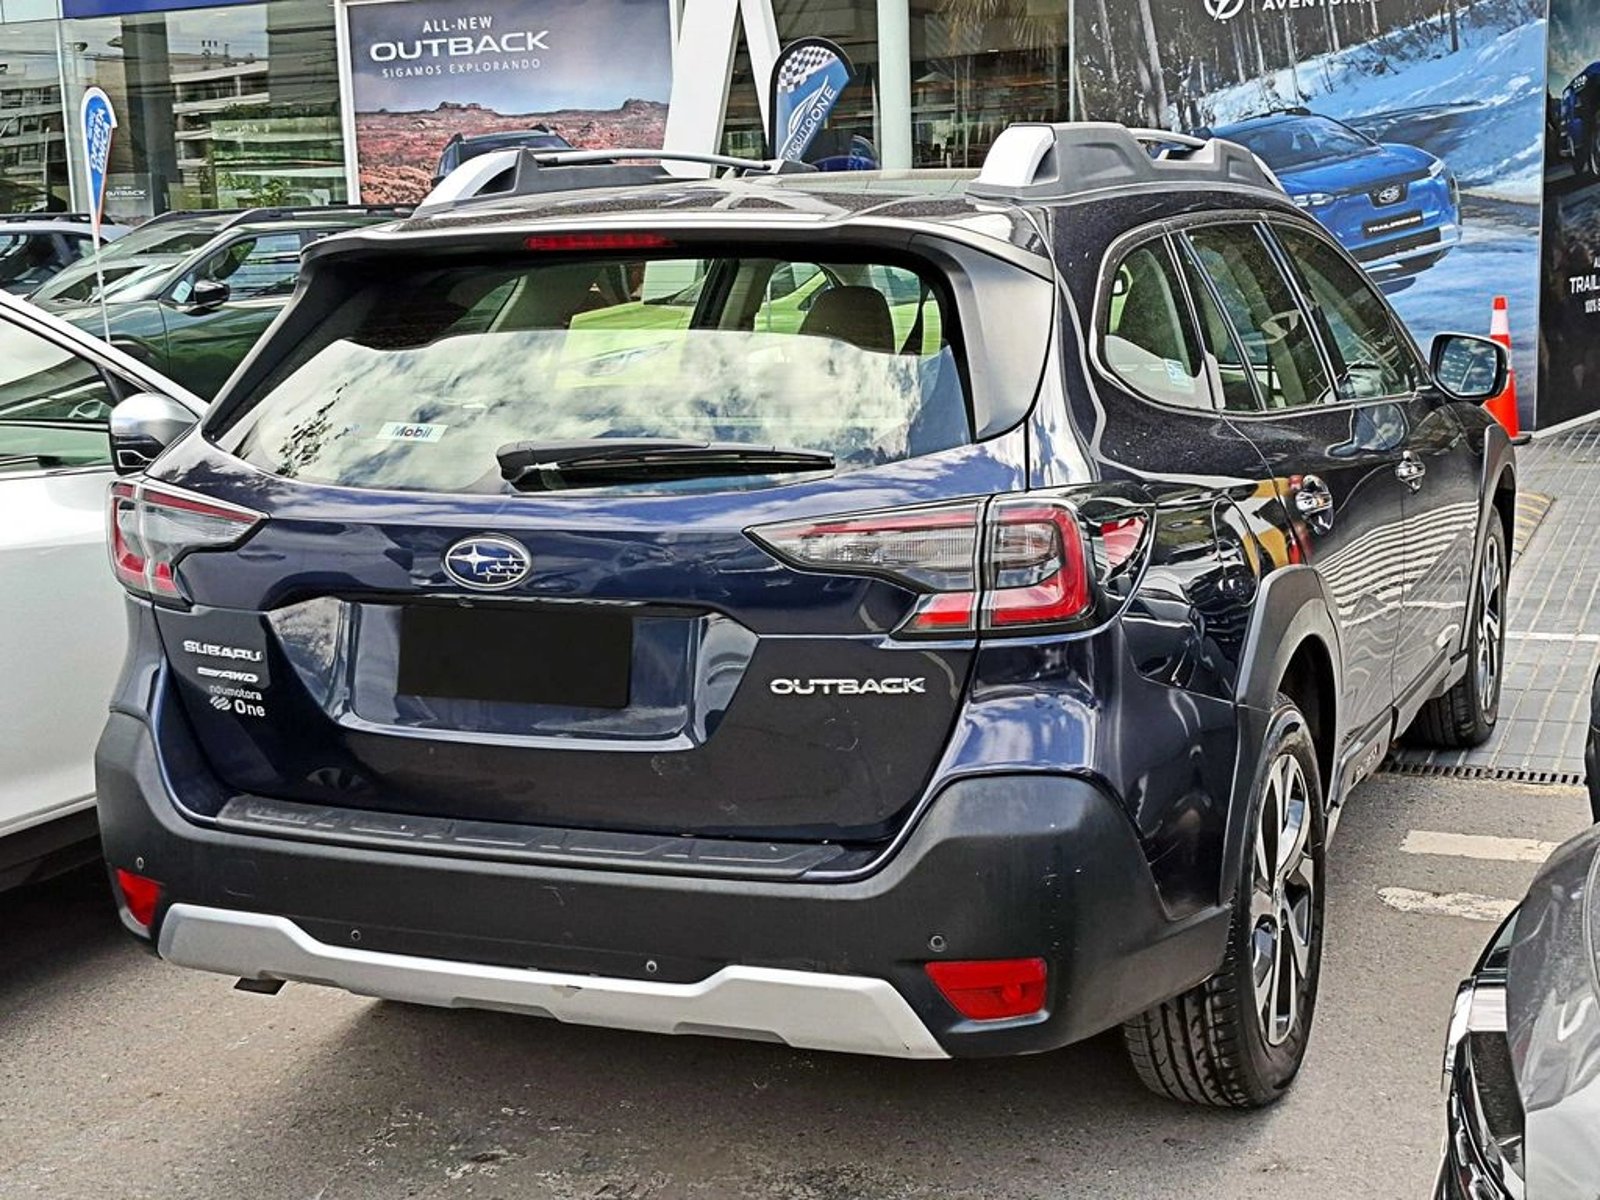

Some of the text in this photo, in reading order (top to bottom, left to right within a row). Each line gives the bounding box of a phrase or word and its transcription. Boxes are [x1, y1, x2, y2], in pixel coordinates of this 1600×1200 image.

[423, 16, 493, 33] ALL-NEW
[369, 30, 550, 62] OUTBACK
[381, 58, 542, 79] SIGAMOS EXPLORANDO
[391, 426, 434, 438] Mobil
[183, 640, 262, 661] SUBARU
[770, 677, 926, 694] OUTBACK
[234, 699, 266, 717] One
